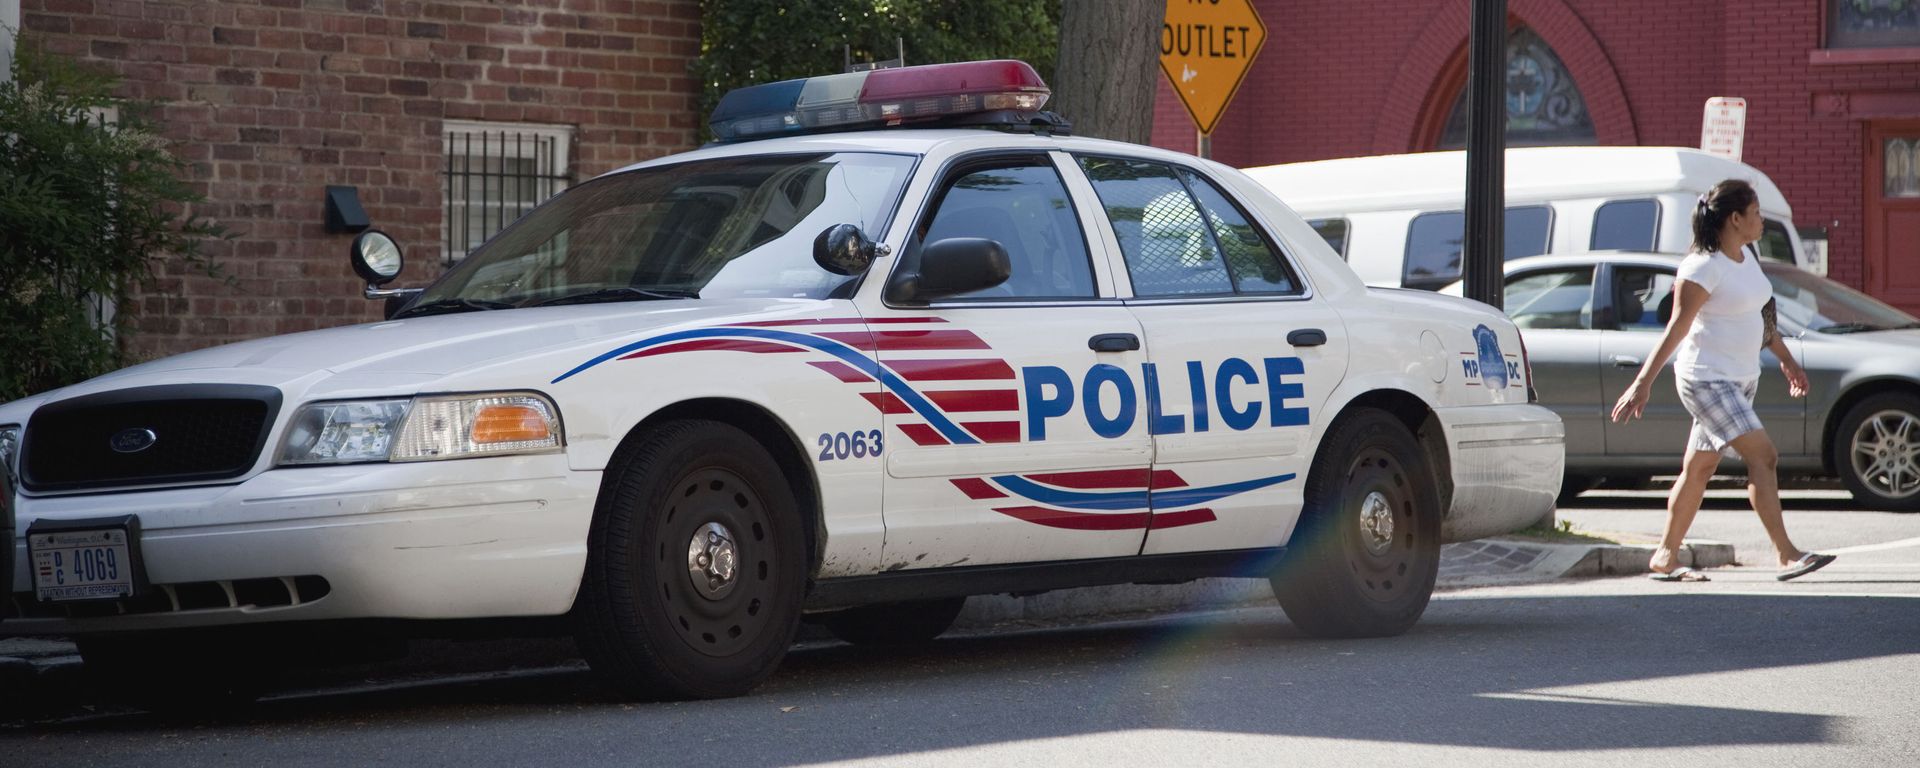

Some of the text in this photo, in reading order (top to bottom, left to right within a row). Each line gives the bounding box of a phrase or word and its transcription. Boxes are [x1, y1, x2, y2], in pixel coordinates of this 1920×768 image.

[1161, 23, 1250, 58] OUTLET
[1462, 359, 1521, 380] MP DC
[1022, 357, 1310, 442] POLICE
[818, 429, 883, 462] 2063
[74, 548, 117, 582] 4069
